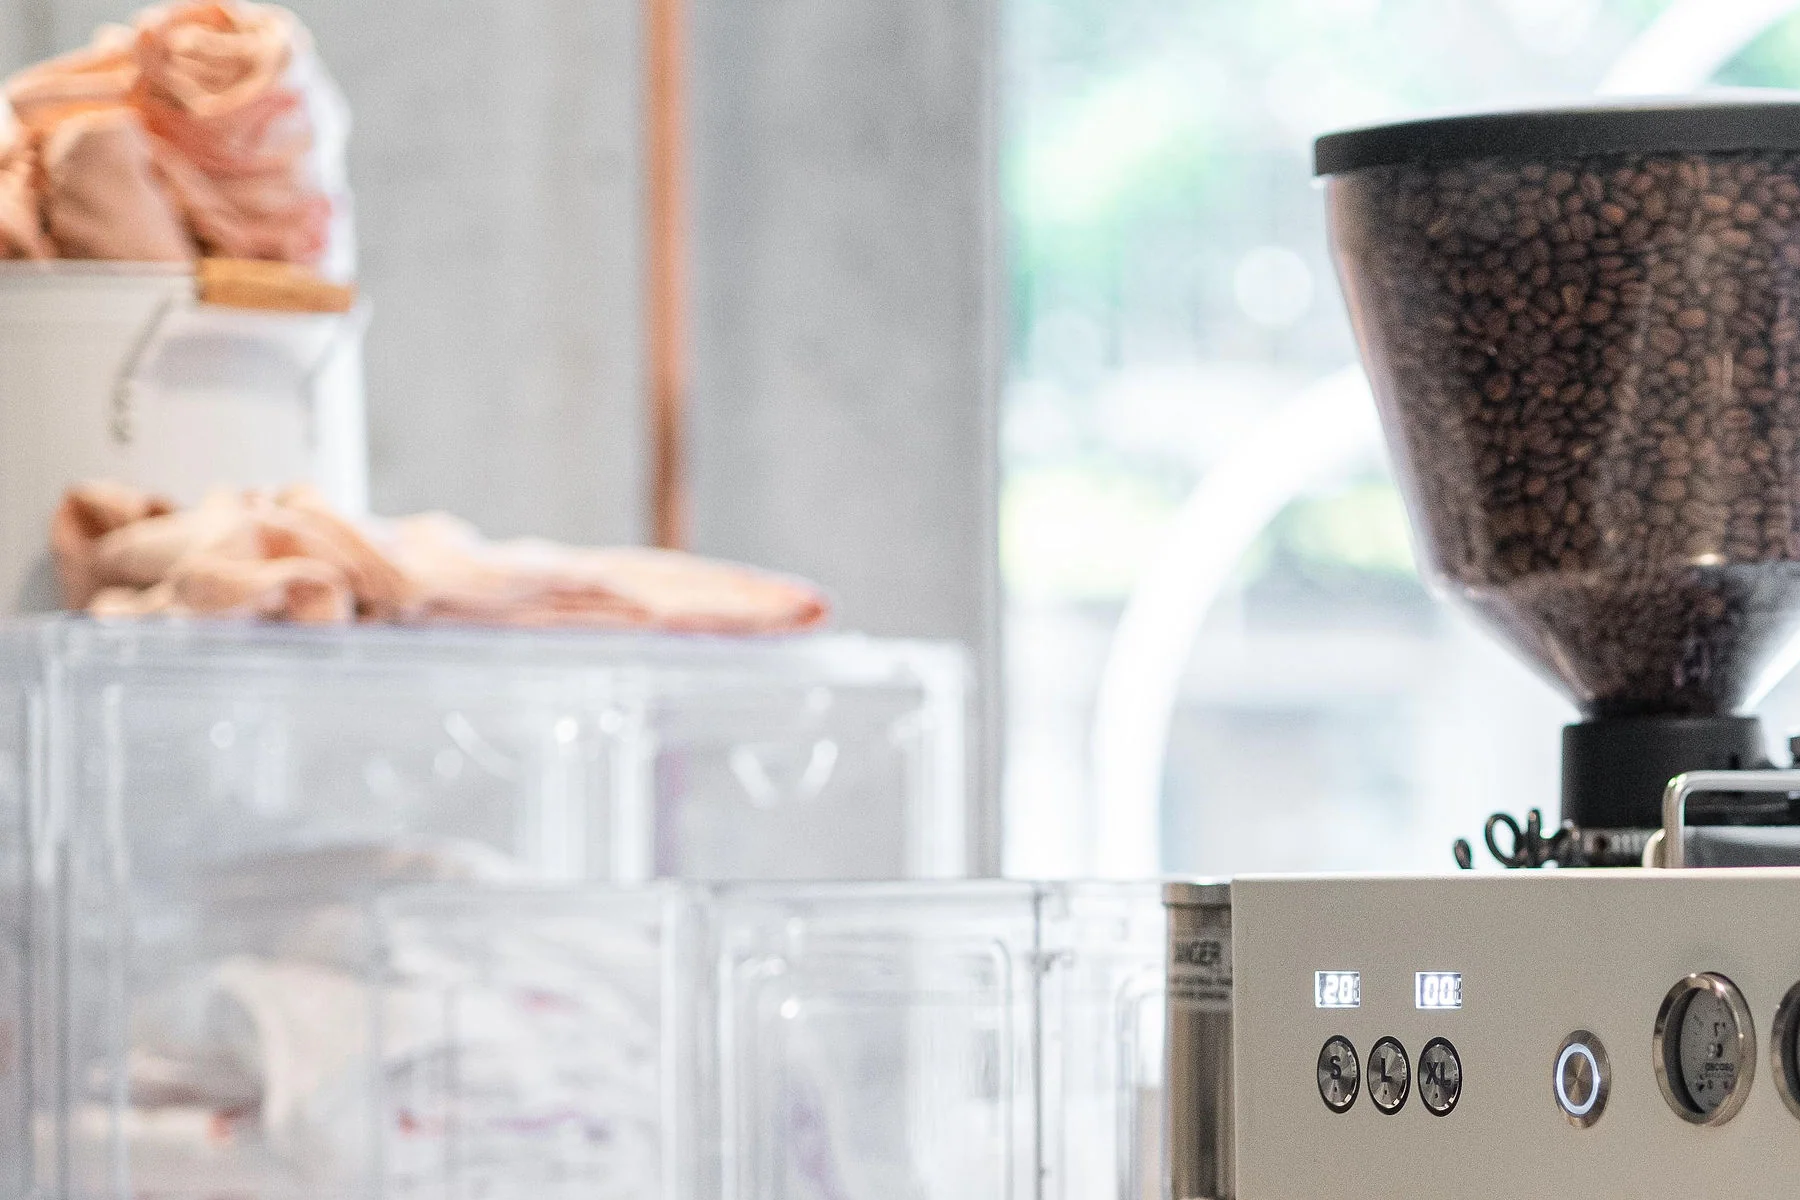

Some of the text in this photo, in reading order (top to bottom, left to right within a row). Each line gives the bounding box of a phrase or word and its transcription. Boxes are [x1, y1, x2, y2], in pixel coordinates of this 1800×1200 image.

[1174, 940, 1221, 967] ANGER
[1329, 1055, 1342, 1080] S
[1380, 1057, 1393, 1083] L
[1425, 1061, 1453, 1086] XL
